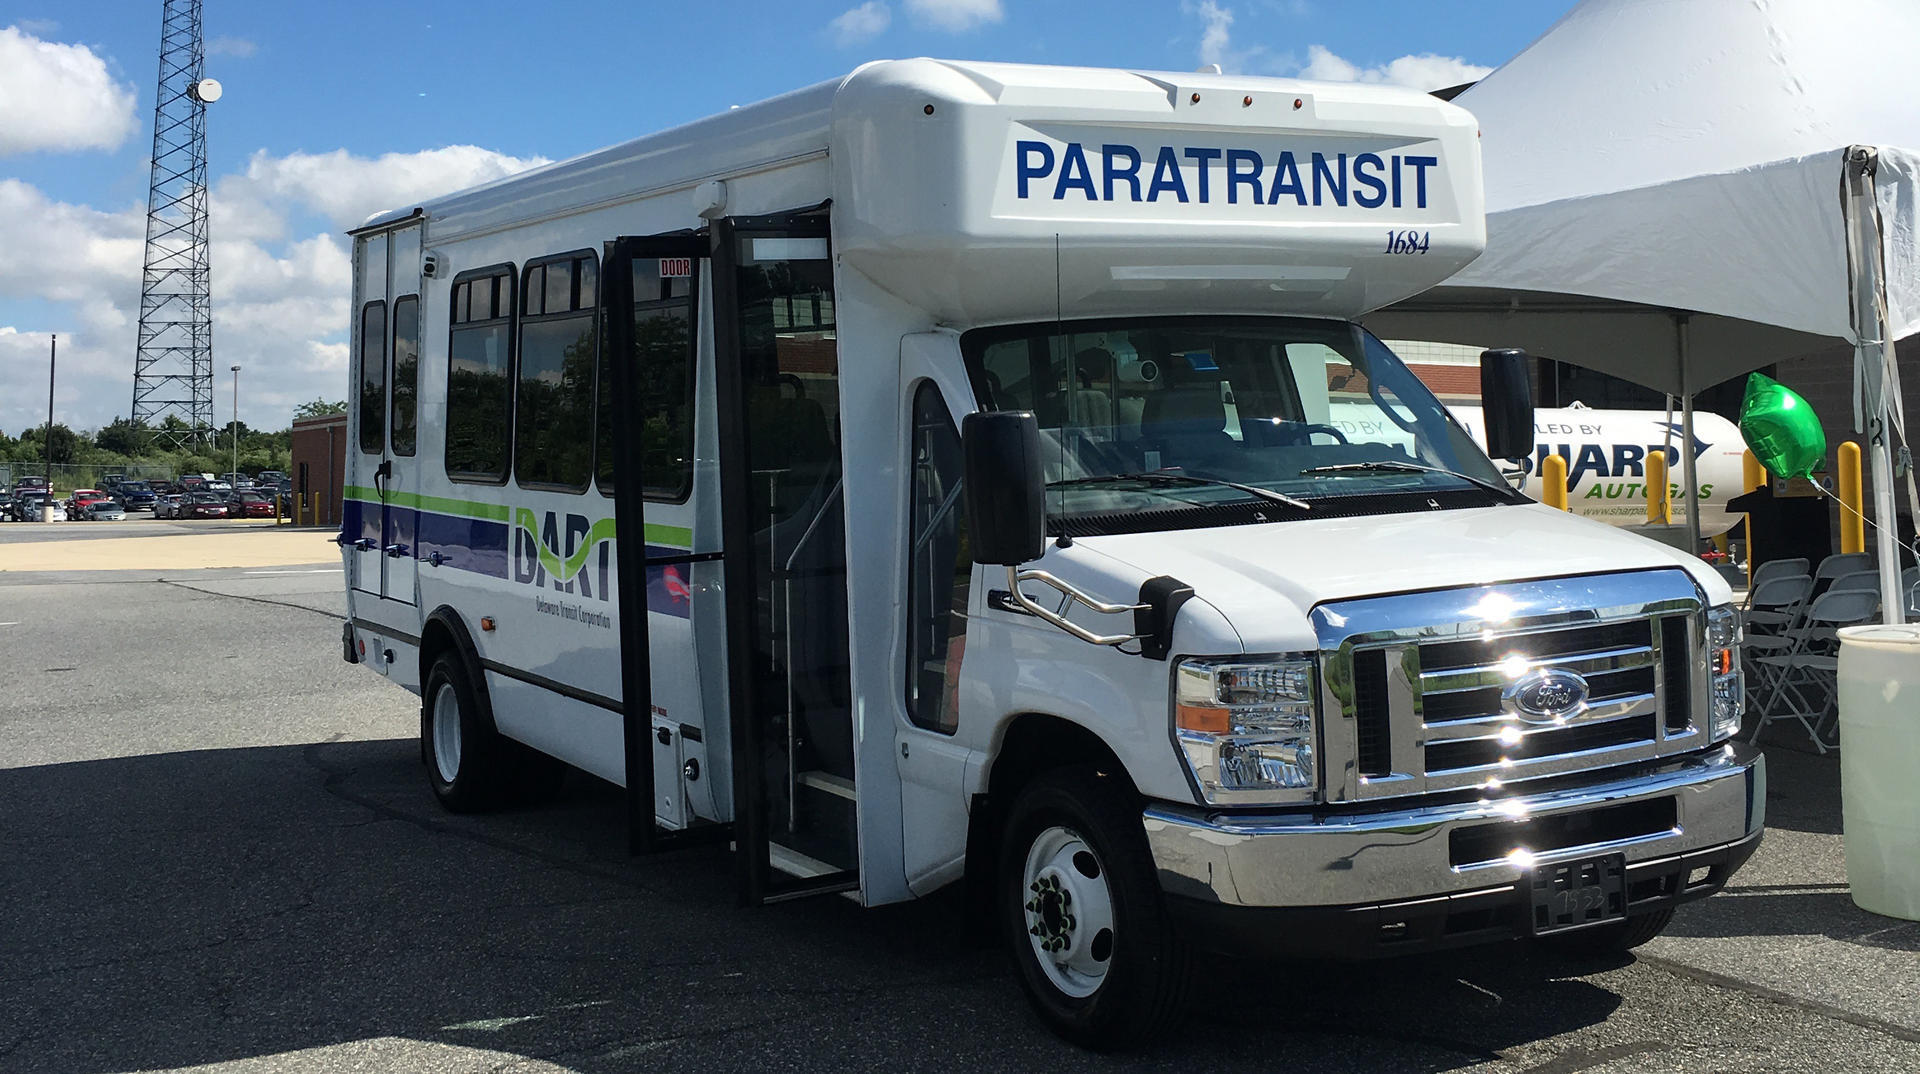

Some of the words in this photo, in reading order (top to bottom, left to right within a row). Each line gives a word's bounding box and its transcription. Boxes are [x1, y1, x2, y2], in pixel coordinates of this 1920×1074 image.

[1015, 140, 1438, 210] PARATRANSIT
[1383, 229, 1430, 255] 1684
[661, 258, 690, 276] DOOR
[1534, 423, 1573, 435] LED
[1579, 424, 1602, 435] BY
[515, 507, 616, 602] DART
[536, 595, 560, 617] Delaware
[560, 600, 578, 621] Transit
[578, 605, 611, 630] Corporation
[1535, 684, 1572, 707] Ford
